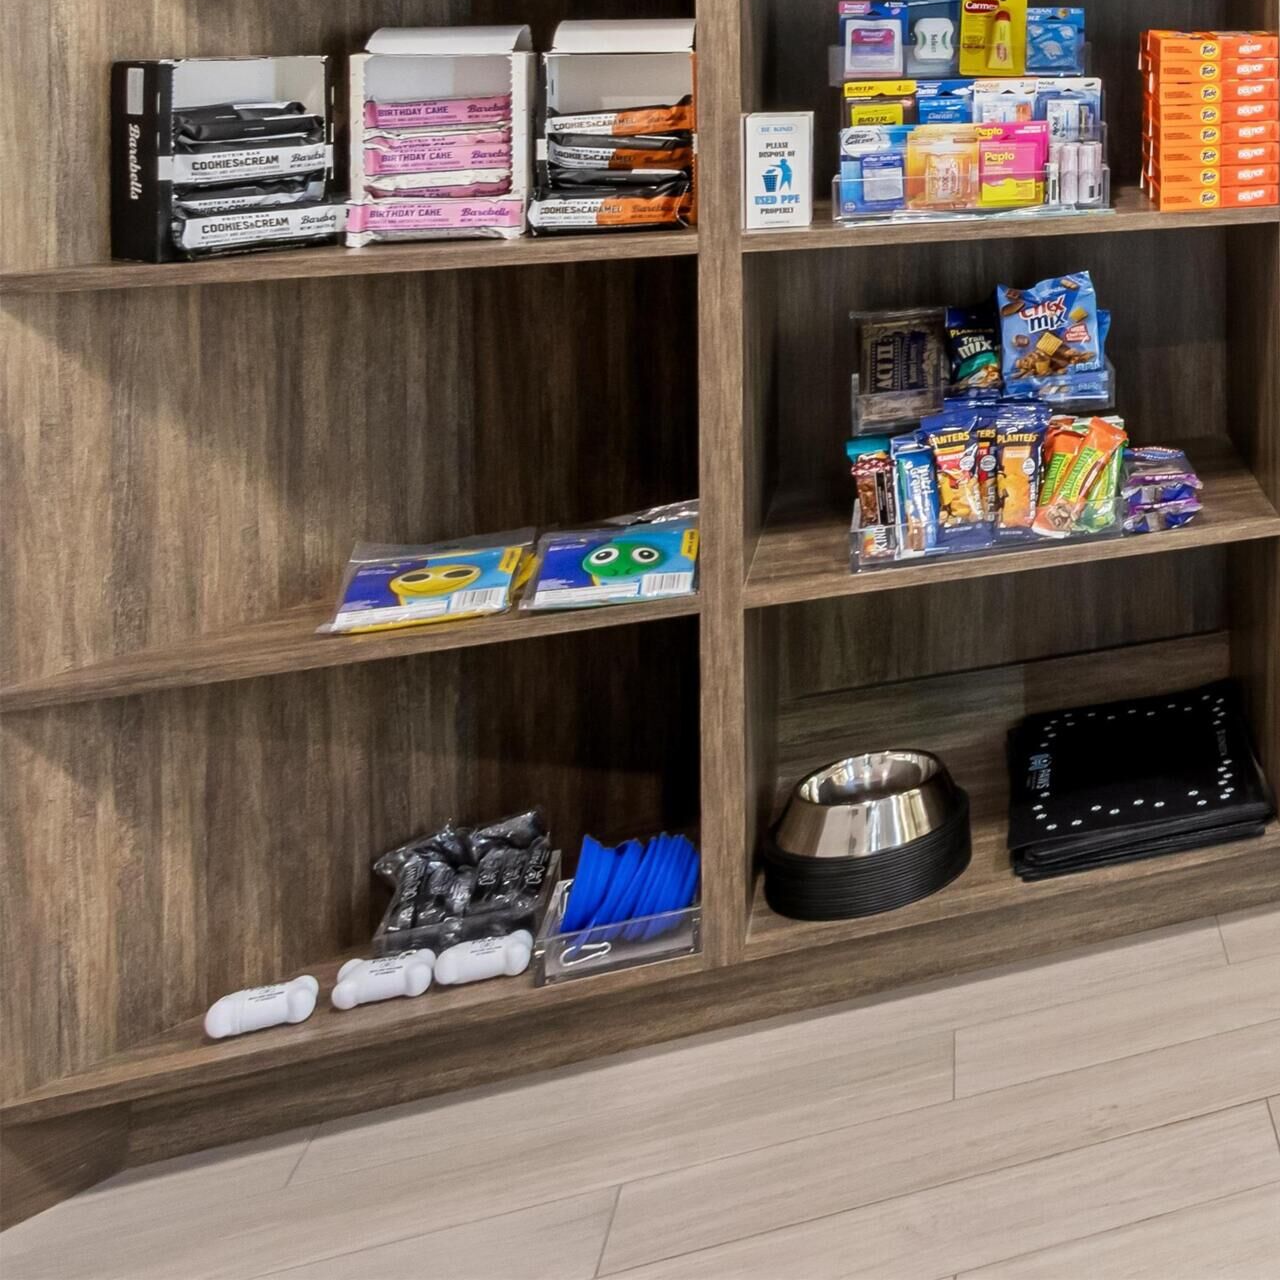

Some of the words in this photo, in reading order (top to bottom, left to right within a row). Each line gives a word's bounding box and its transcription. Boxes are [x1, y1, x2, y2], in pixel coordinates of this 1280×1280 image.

[965, 1, 999, 11] Carmex
[378, 108, 422, 117] BIRTHDAY
[425, 106, 449, 114] CAKE
[976, 127, 1003, 137] Pepto
[129, 123, 142, 200] Barebells
[381, 154, 426, 162] BIRTHDAY
[984, 152, 1015, 162] Pepto
[755, 196, 777, 205] USED
[781, 194, 800, 204] PPE
[369, 210, 416, 218] BIRTHDAY
[418, 208, 442, 216] CAKE
[760, 207, 794, 215] PROPERLY
[1029, 311, 1067, 331] mix
